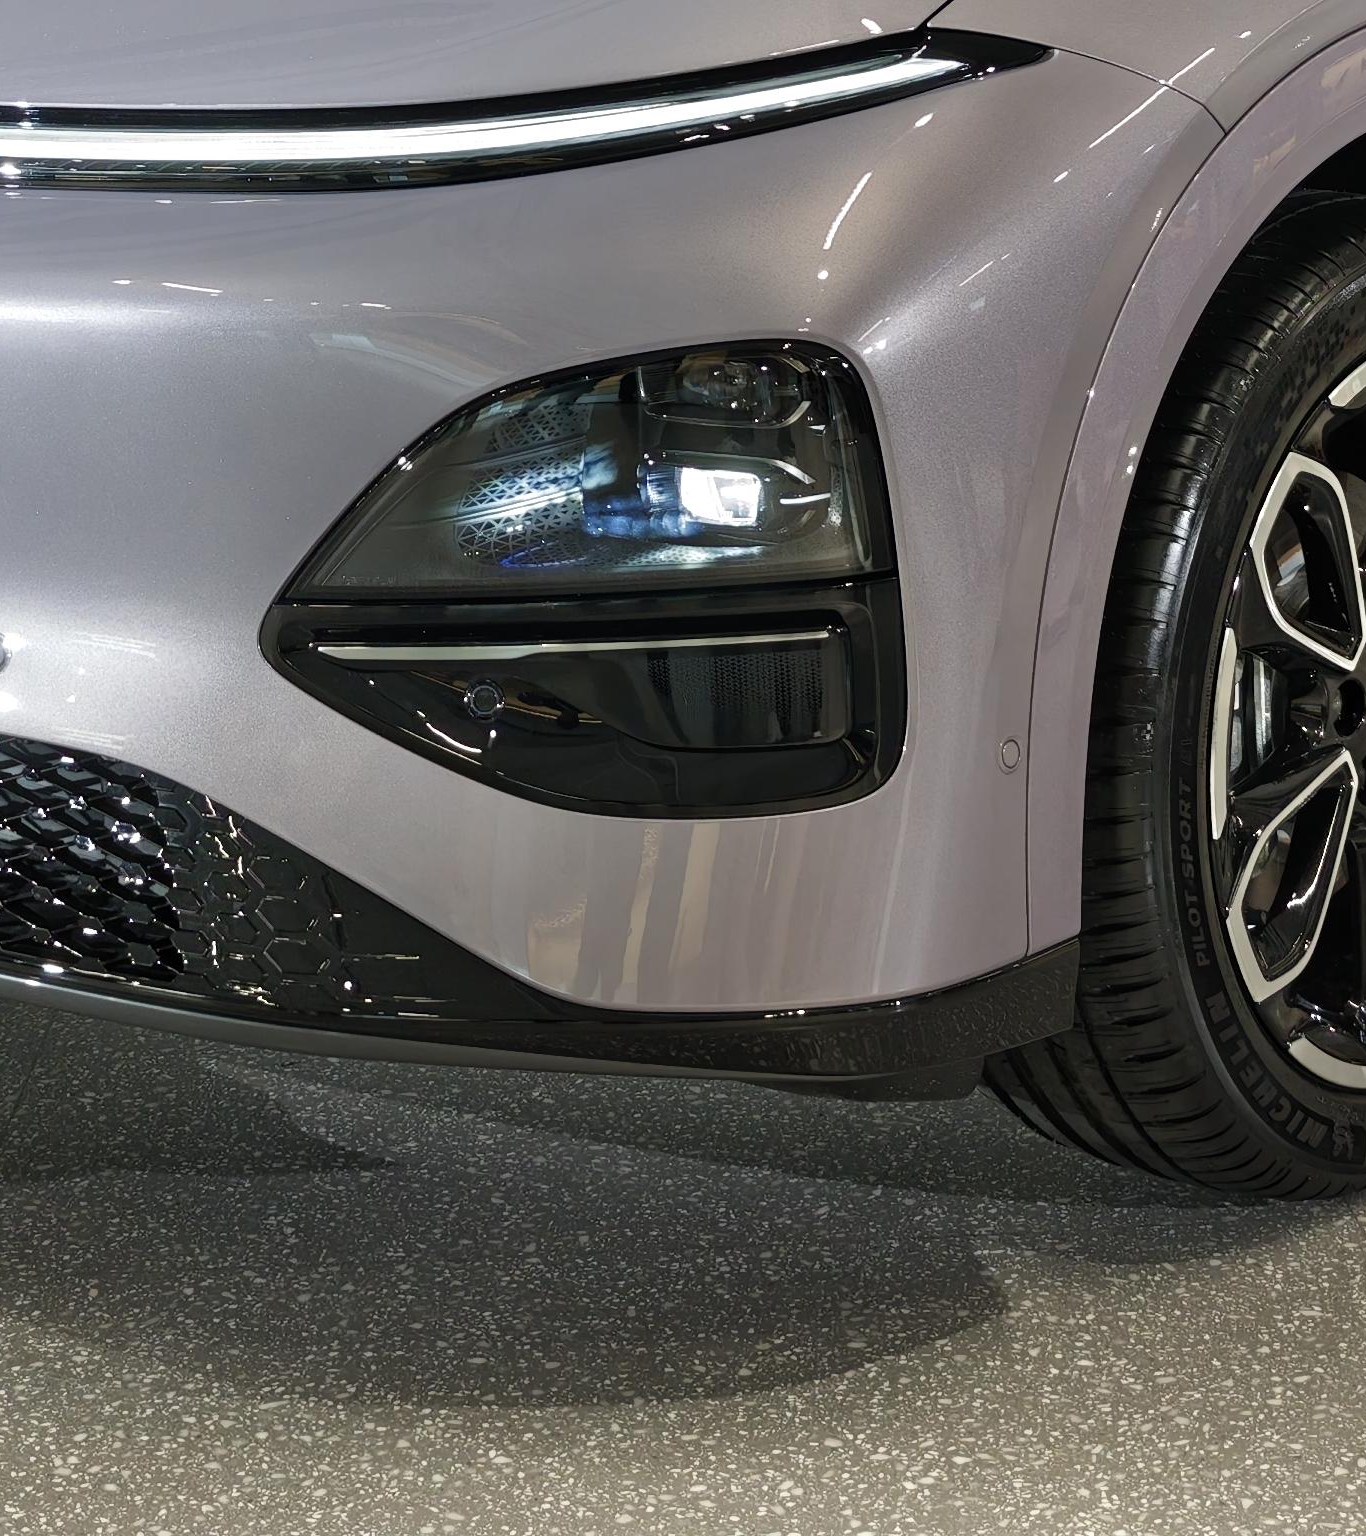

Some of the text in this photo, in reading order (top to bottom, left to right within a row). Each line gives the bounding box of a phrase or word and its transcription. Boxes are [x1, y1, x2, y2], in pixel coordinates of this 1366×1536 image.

[1178, 776, 1195, 880] SPORT
[1183, 889, 1211, 968] PILOT
[1204, 991, 1332, 1150] MICHELIN
